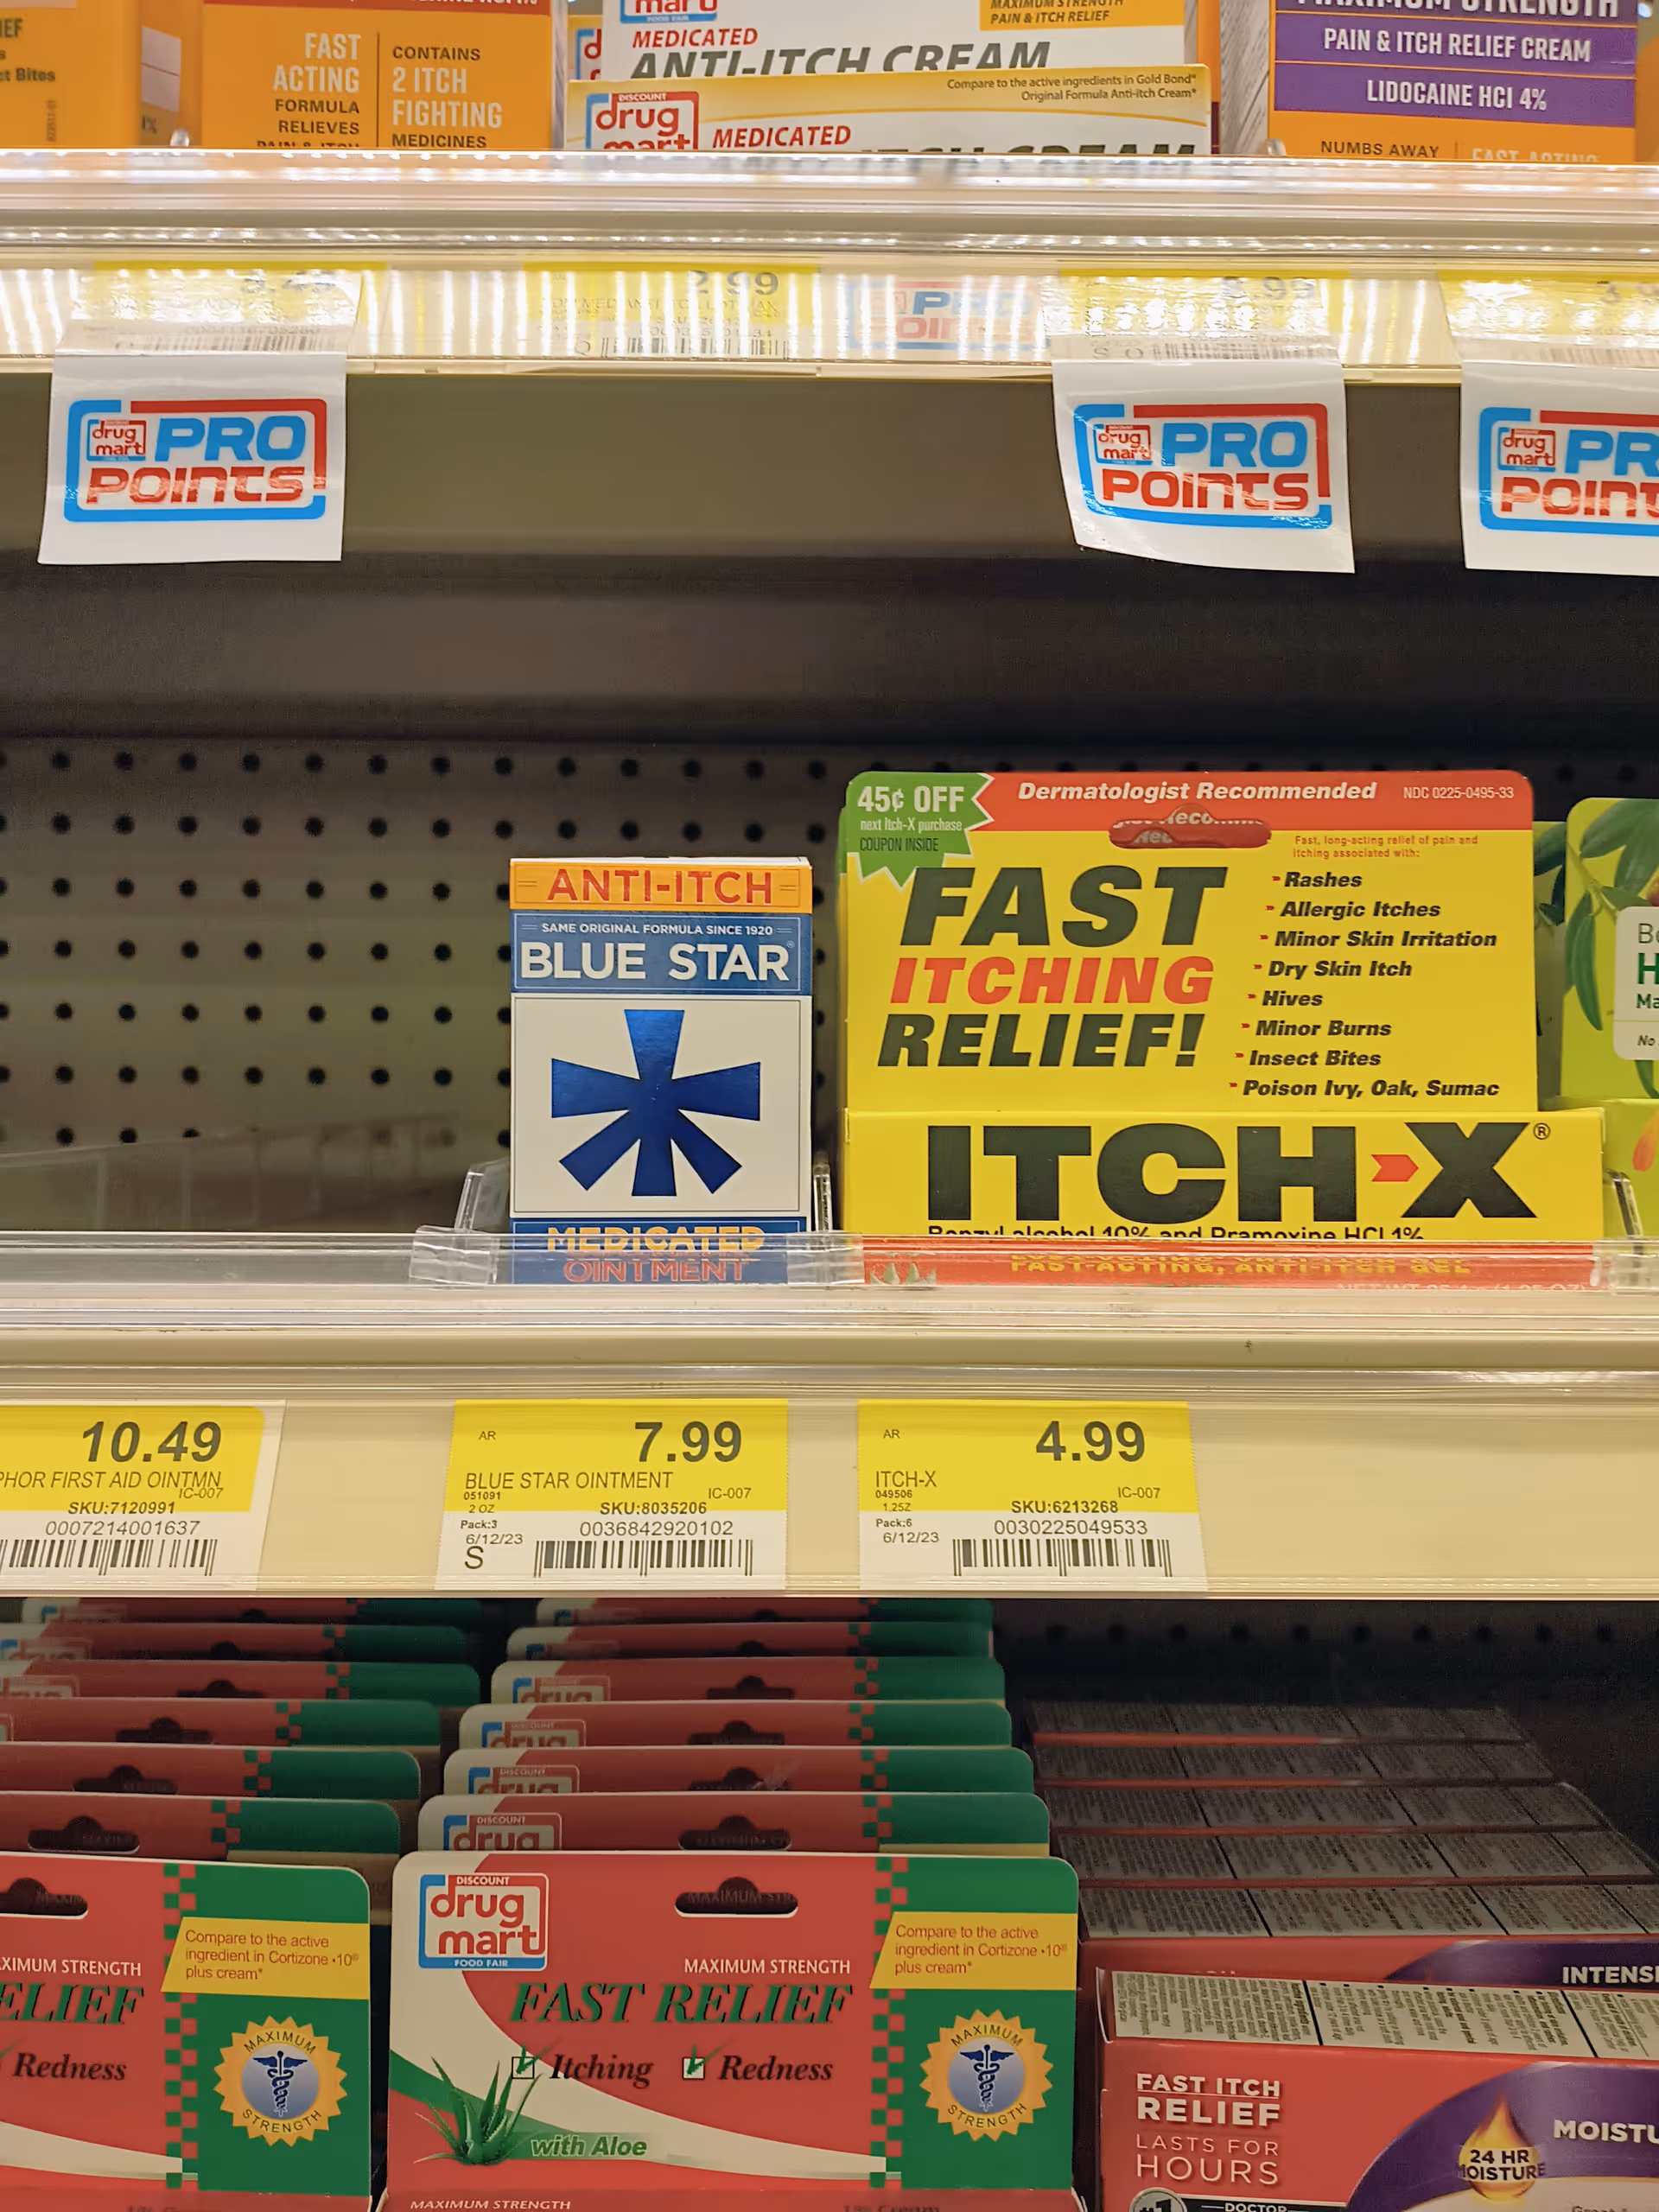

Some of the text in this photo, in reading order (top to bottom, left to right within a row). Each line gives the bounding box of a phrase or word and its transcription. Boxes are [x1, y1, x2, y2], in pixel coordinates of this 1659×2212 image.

[990, 10, 1110, 24] PAIN & ITCH RELIEF
[304, 32, 361, 60] FAST
[632, 28, 759, 49] MEDICATED
[1324, 29, 1592, 62] PAIN & ITCH RELIEF CREAM
[392, 46, 481, 61] CONTAINS
[630, 41, 1051, 79] ANTI-ITCH CREAM
[272, 65, 360, 93] ACTING
[392, 67, 467, 94] 2 ITCH
[947, 79, 995, 92] Compare
[996, 79, 1008, 88] to
[1009, 78, 1027, 88] the
[1028, 77, 1060, 87] active
[1062, 75, 1122, 90] ingredients
[1123, 75, 1135, 86] in
[1136, 74, 1161, 86] Gold
[619, 92, 667, 102] DISCOUNT
[1021, 90, 1064, 103] Original
[1065, 89, 1109, 100] Formula
[1110, 88, 1156, 99] Anti-itch
[1367, 79, 1472, 107] LIDOCAINE
[1518, 87, 1548, 111] 4%
[275, 99, 360, 114] FORMULA
[392, 99, 503, 128] FIGHTING
[595, 95, 679, 137] drug
[278, 120, 360, 136] RELIEVES
[711, 125, 852, 149] MEDICATED
[391, 133, 487, 149] MEDICINES
[1320, 141, 1440, 159] NUMBS AWAY
[92, 420, 137, 443] drug
[154, 415, 307, 462] PRO
[96, 442, 145, 455] mart
[1160, 420, 1308, 468] PRO
[86, 466, 306, 505] POINTS
[1101, 467, 1309, 512] POINTS
[857, 785, 965, 813] 45¢ OFF
[1018, 781, 1377, 804] Dermatologist Recommended
[1403, 786, 1515, 800] NDC 0225-0495-33
[861, 817, 963, 834] next purchase
[861, 837, 939, 852] COUPON INSIDE
[1324, 836, 1384, 847] long-acting
[1387, 836, 1415, 845] relief
[1419, 836, 1430, 845] of
[1433, 836, 1456, 847] pain
[1459, 836, 1478, 845] and
[1333, 849, 1391, 859] associated
[545, 868, 772, 905] ANTI-ITCH
[1284, 871, 1363, 888] Rashes
[899, 865, 1229, 948] FAST
[1280, 901, 1441, 920] Allergic Itches
[541, 922, 773, 936] SAME ORIGINAL FORMULA SINCE 1920
[1274, 931, 1497, 947] Minor Skin Irritation
[521, 941, 646, 980] BLUE
[1268, 961, 1413, 981] Dry Skin Itch
[890, 956, 1214, 1005] ITCHING
[1262, 990, 1324, 1007] Hives
[1255, 1020, 1392, 1036] Minor Burns
[877, 1014, 1205, 1067] RELIEF!
[1249, 1051, 1382, 1066] Insect Bites
[1243, 1080, 1500, 1098] Poison Ivy, Oak, Sumac
[547, 1225, 766, 1251] MEDICATED
[563, 1260, 746, 1283] OINTMENT
[82, 1421, 222, 1463] 10.49
[479, 1430, 497, 1440] AR
[634, 1420, 742, 1463] 7.99
[882, 1429, 901, 1440] AR
[1035, 1420, 1146, 1463] 4.99
[50, 1471, 107, 1488] FIRST
[109, 1471, 142, 1488] AID
[147, 1471, 222, 1488] OINTMN
[465, 1471, 674, 1490] BLUE STAR OINTMENT
[874, 1470, 938, 1489] ITCH-X
[178, 1487, 224, 1499] IC-007
[463, 1491, 501, 1501] 051091
[708, 1487, 752, 1499] IC-007
[874, 1489, 913, 1499] 049506
[1117, 1486, 1161, 1499] IC-007
[67, 1501, 176, 1515] SKU:7120991
[468, 1503, 495, 1514] 2 OZ
[600, 1502, 708, 1516] SKU:8035206
[882, 1503, 912, 1512] 1.25Z
[1011, 1500, 1119, 1514] SKU:6213268
[45, 1520, 201, 1535] 0007214001637
[460, 1519, 498, 1529] Pack:3
[579, 1520, 734, 1536] 0036842920102
[875, 1518, 912, 1529] Pack:6
[994, 1519, 1148, 1535] 0030225049533
[466, 1533, 524, 1546] 6/12/23
[882, 1531, 940, 1544] 6/12/23
[464, 1545, 485, 1570] S
[456, 1875, 510, 1885] DISCOUNT
[430, 1878, 524, 1929] drug
[438, 1924, 546, 1955] mart
[895, 1924, 1039, 1941] Compare to the active
[895, 1942, 1038, 1959] ingredient in Cortizone
[454, 1958, 508, 1967] FOOD FAIR
[684, 1959, 851, 1974] MAXIMUM STRENGTH
[894, 1961, 923, 1976] plus
[506, 1981, 853, 2024] FAST RELIEF
[950, 2024, 1024, 2047] MAXIMUM
[549, 2053, 834, 2089] Itching Redness
[1136, 2072, 1281, 2097] FAST ITCH
[947, 2102, 1027, 2129] STRENGTH
[1137, 2095, 1281, 2126] RELIEF
[531, 2134, 648, 2158] with Aloe
[1136, 2133, 1279, 2157] LASTS FOR
[1470, 2149, 1530, 2164] 24 HR
[1136, 2153, 1279, 2186] HOURS
[1458, 2160, 1547, 2181] MOISTURE
